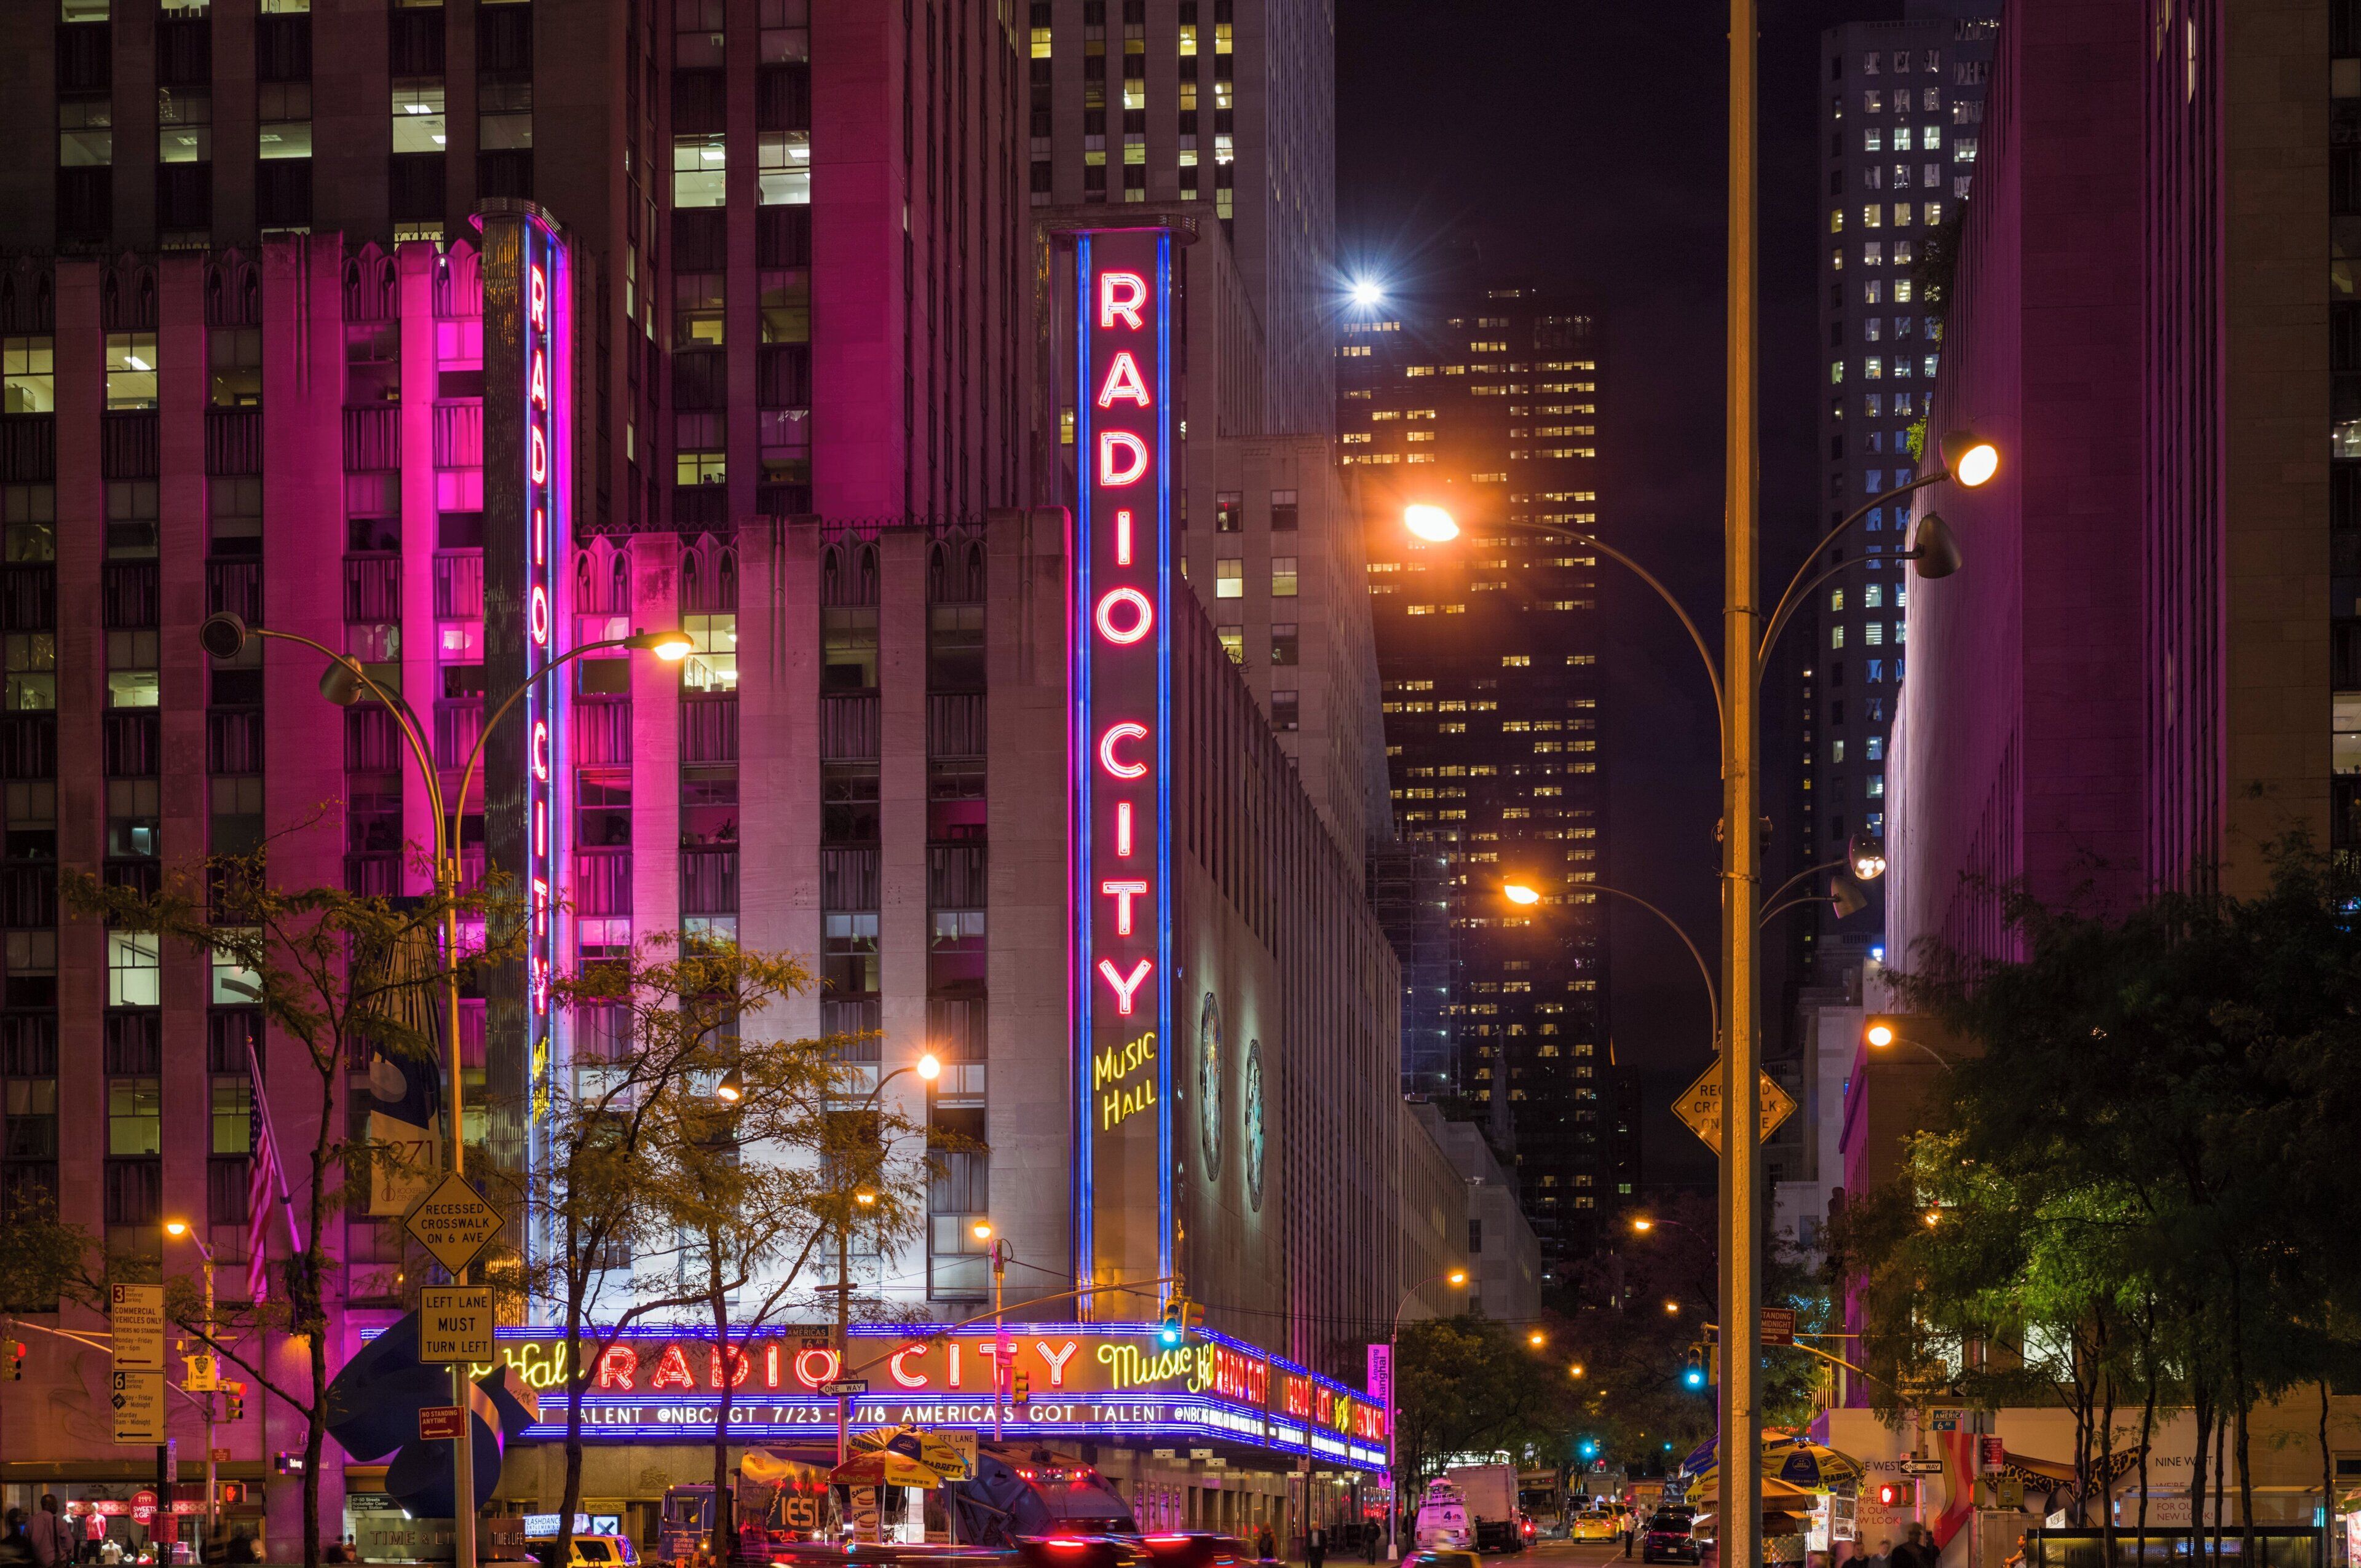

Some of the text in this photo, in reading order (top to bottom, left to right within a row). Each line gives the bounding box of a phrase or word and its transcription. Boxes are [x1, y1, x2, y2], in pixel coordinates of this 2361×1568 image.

[532, 264, 547, 644] RADIO
[1097, 274, 1152, 1014] RADIO CITY
[1096, 1031, 1156, 1091] MUSIC
[1104, 1079, 1156, 1132] HALL
[426, 1204, 484, 1215] RECESSED
[421, 1218, 489, 1229] CROSSWALK
[428, 1232, 483, 1243] ON 6 AVE
[115, 1286, 123, 1303] 3
[427, 1296, 488, 1308] LEFT LANE
[115, 1307, 156, 1315] COMMERCIAL
[1761, 1312, 1791, 1320] TANDING
[438, 1318, 475, 1331] MUST
[1761, 1320, 1791, 1329] MIDNIGHT
[427, 1341, 488, 1352] TURN LEFT
[806, 1340, 813, 1349] 6
[503, 1340, 585, 1388] Hal
[600, 1342, 839, 1390] RADIO
[890, 1341, 1077, 1389] CITY
[1097, 1344, 1192, 1390] Music
[115, 1373, 123, 1390] 6
[1378, 1356, 1388, 1401] hanghai
[1030, 1406, 1075, 1422] GOT
[1091, 1405, 1164, 1422] TALENT
[1875, 1461, 1900, 1471] WEST
[2155, 1456, 2213, 1467] NINE WT
[852, 1486, 875, 1498] SABRETT
[781, 1497, 819, 1527] IESI
[2157, 1502, 2175, 1511] FOR
[853, 1510, 876, 1521] SABRETT
[1444, 1511, 1452, 1520] 4
[370, 1531, 415, 1545] TIME
[419, 1533, 430, 1545] &
